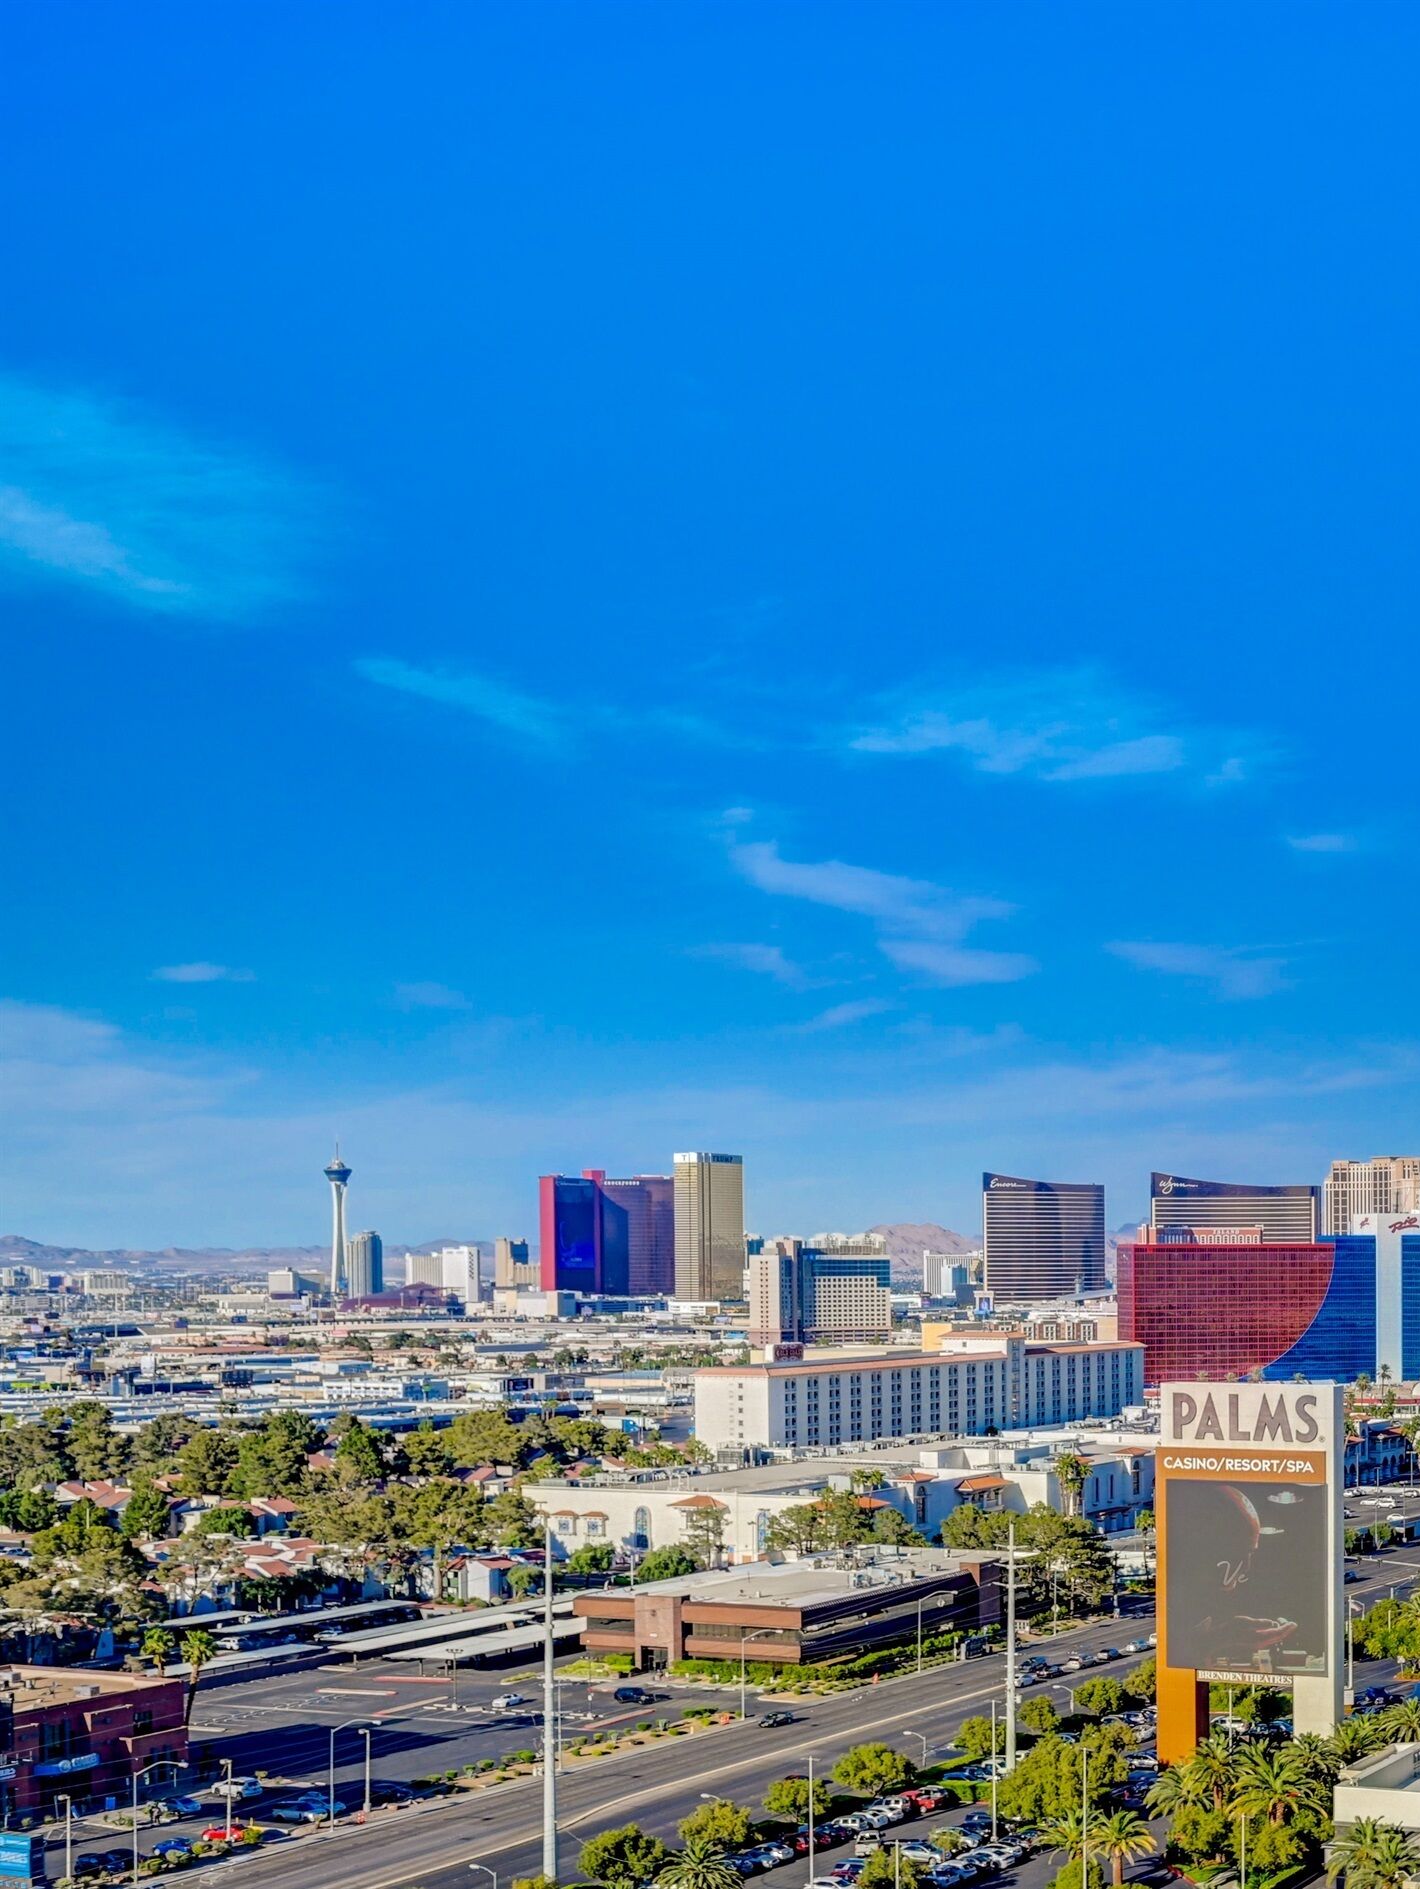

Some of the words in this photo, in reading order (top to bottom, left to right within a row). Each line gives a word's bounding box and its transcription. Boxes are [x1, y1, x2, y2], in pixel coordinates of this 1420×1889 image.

[990, 1178, 1026, 1189] Encore
[1388, 1216, 1420, 1233] Rio
[1172, 1391, 1319, 1444] PALMS
[1163, 1456, 1315, 1474] CASINO/RESORT/SPA
[1198, 1670, 1242, 1682] BRENDEN
[1243, 1673, 1293, 1685] THEATRES
